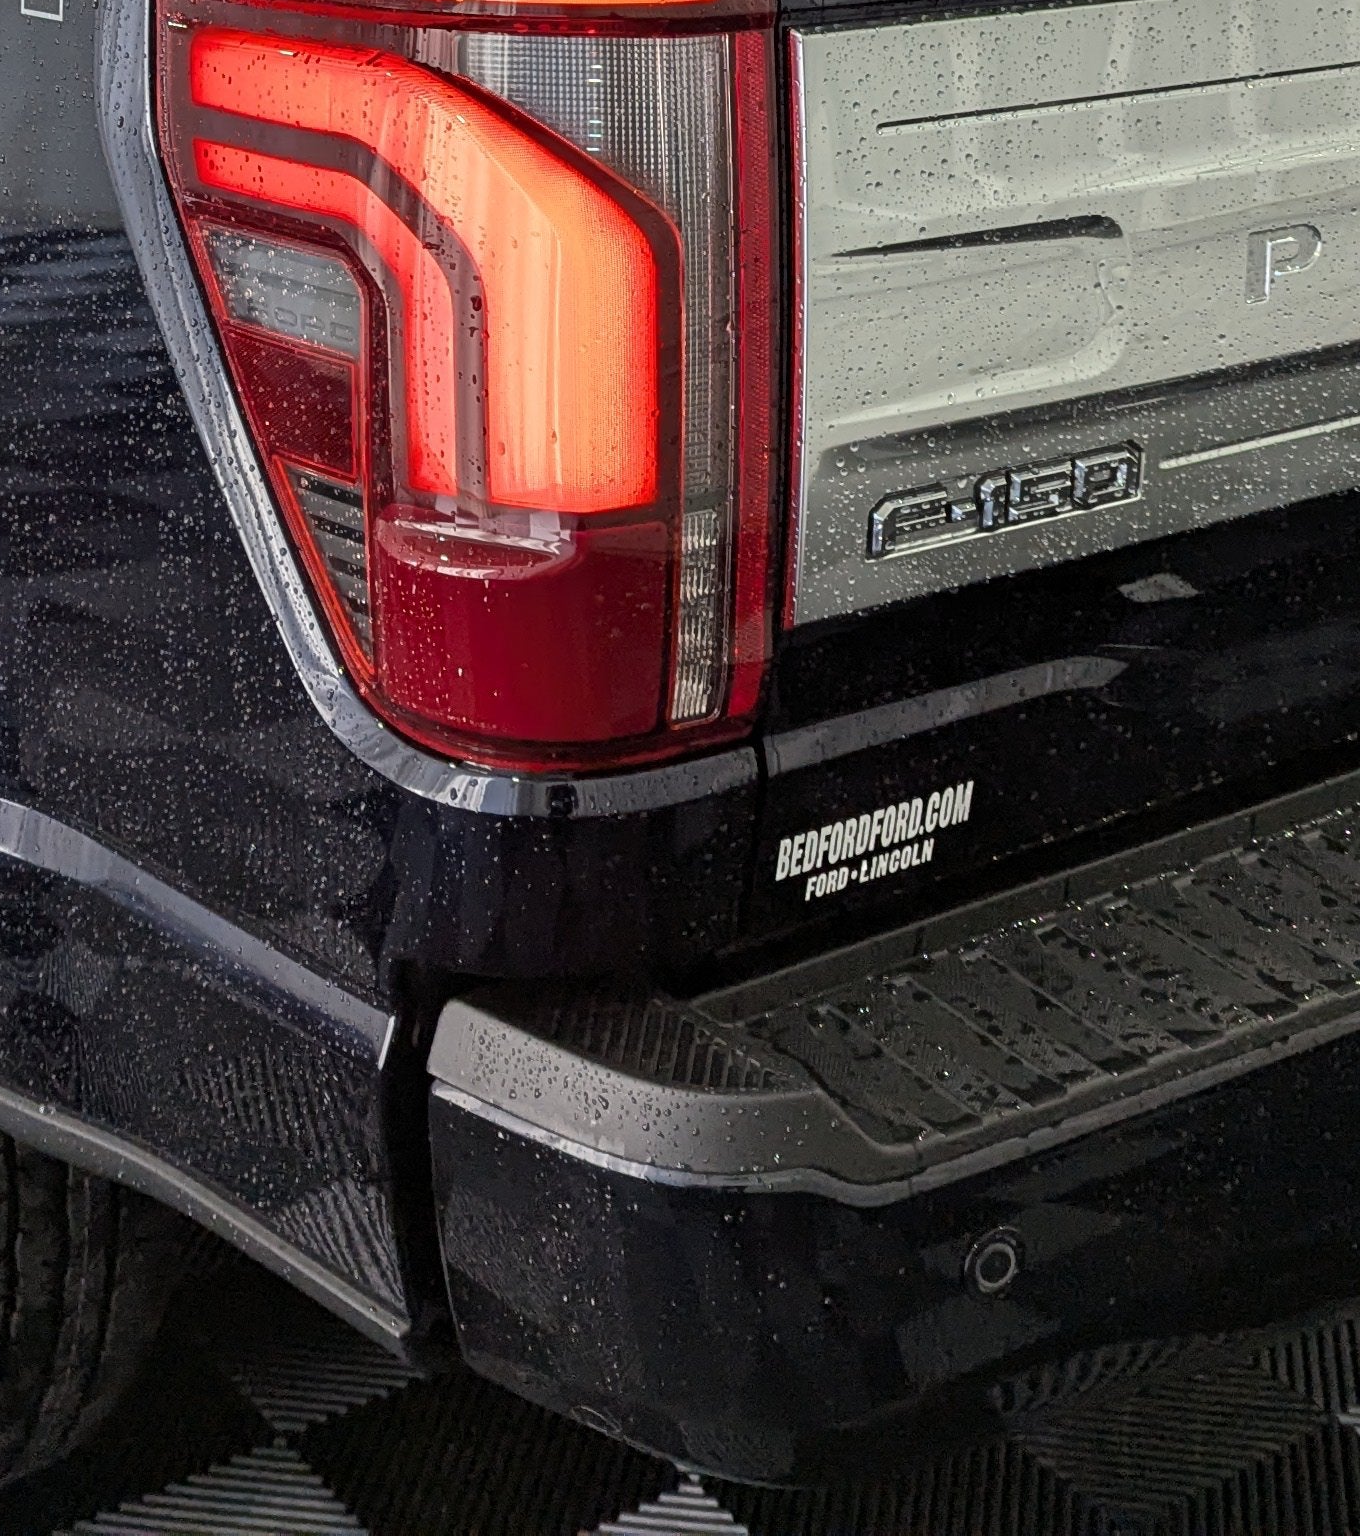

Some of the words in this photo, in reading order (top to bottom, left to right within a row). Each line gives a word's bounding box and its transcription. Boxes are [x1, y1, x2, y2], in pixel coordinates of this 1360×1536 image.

[865, 439, 1146, 564] F-150
[775, 780, 975, 882] BEDFORDFORD.COM
[804, 866, 850, 902] FORD
[859, 838, 935, 884] LINCOLN
